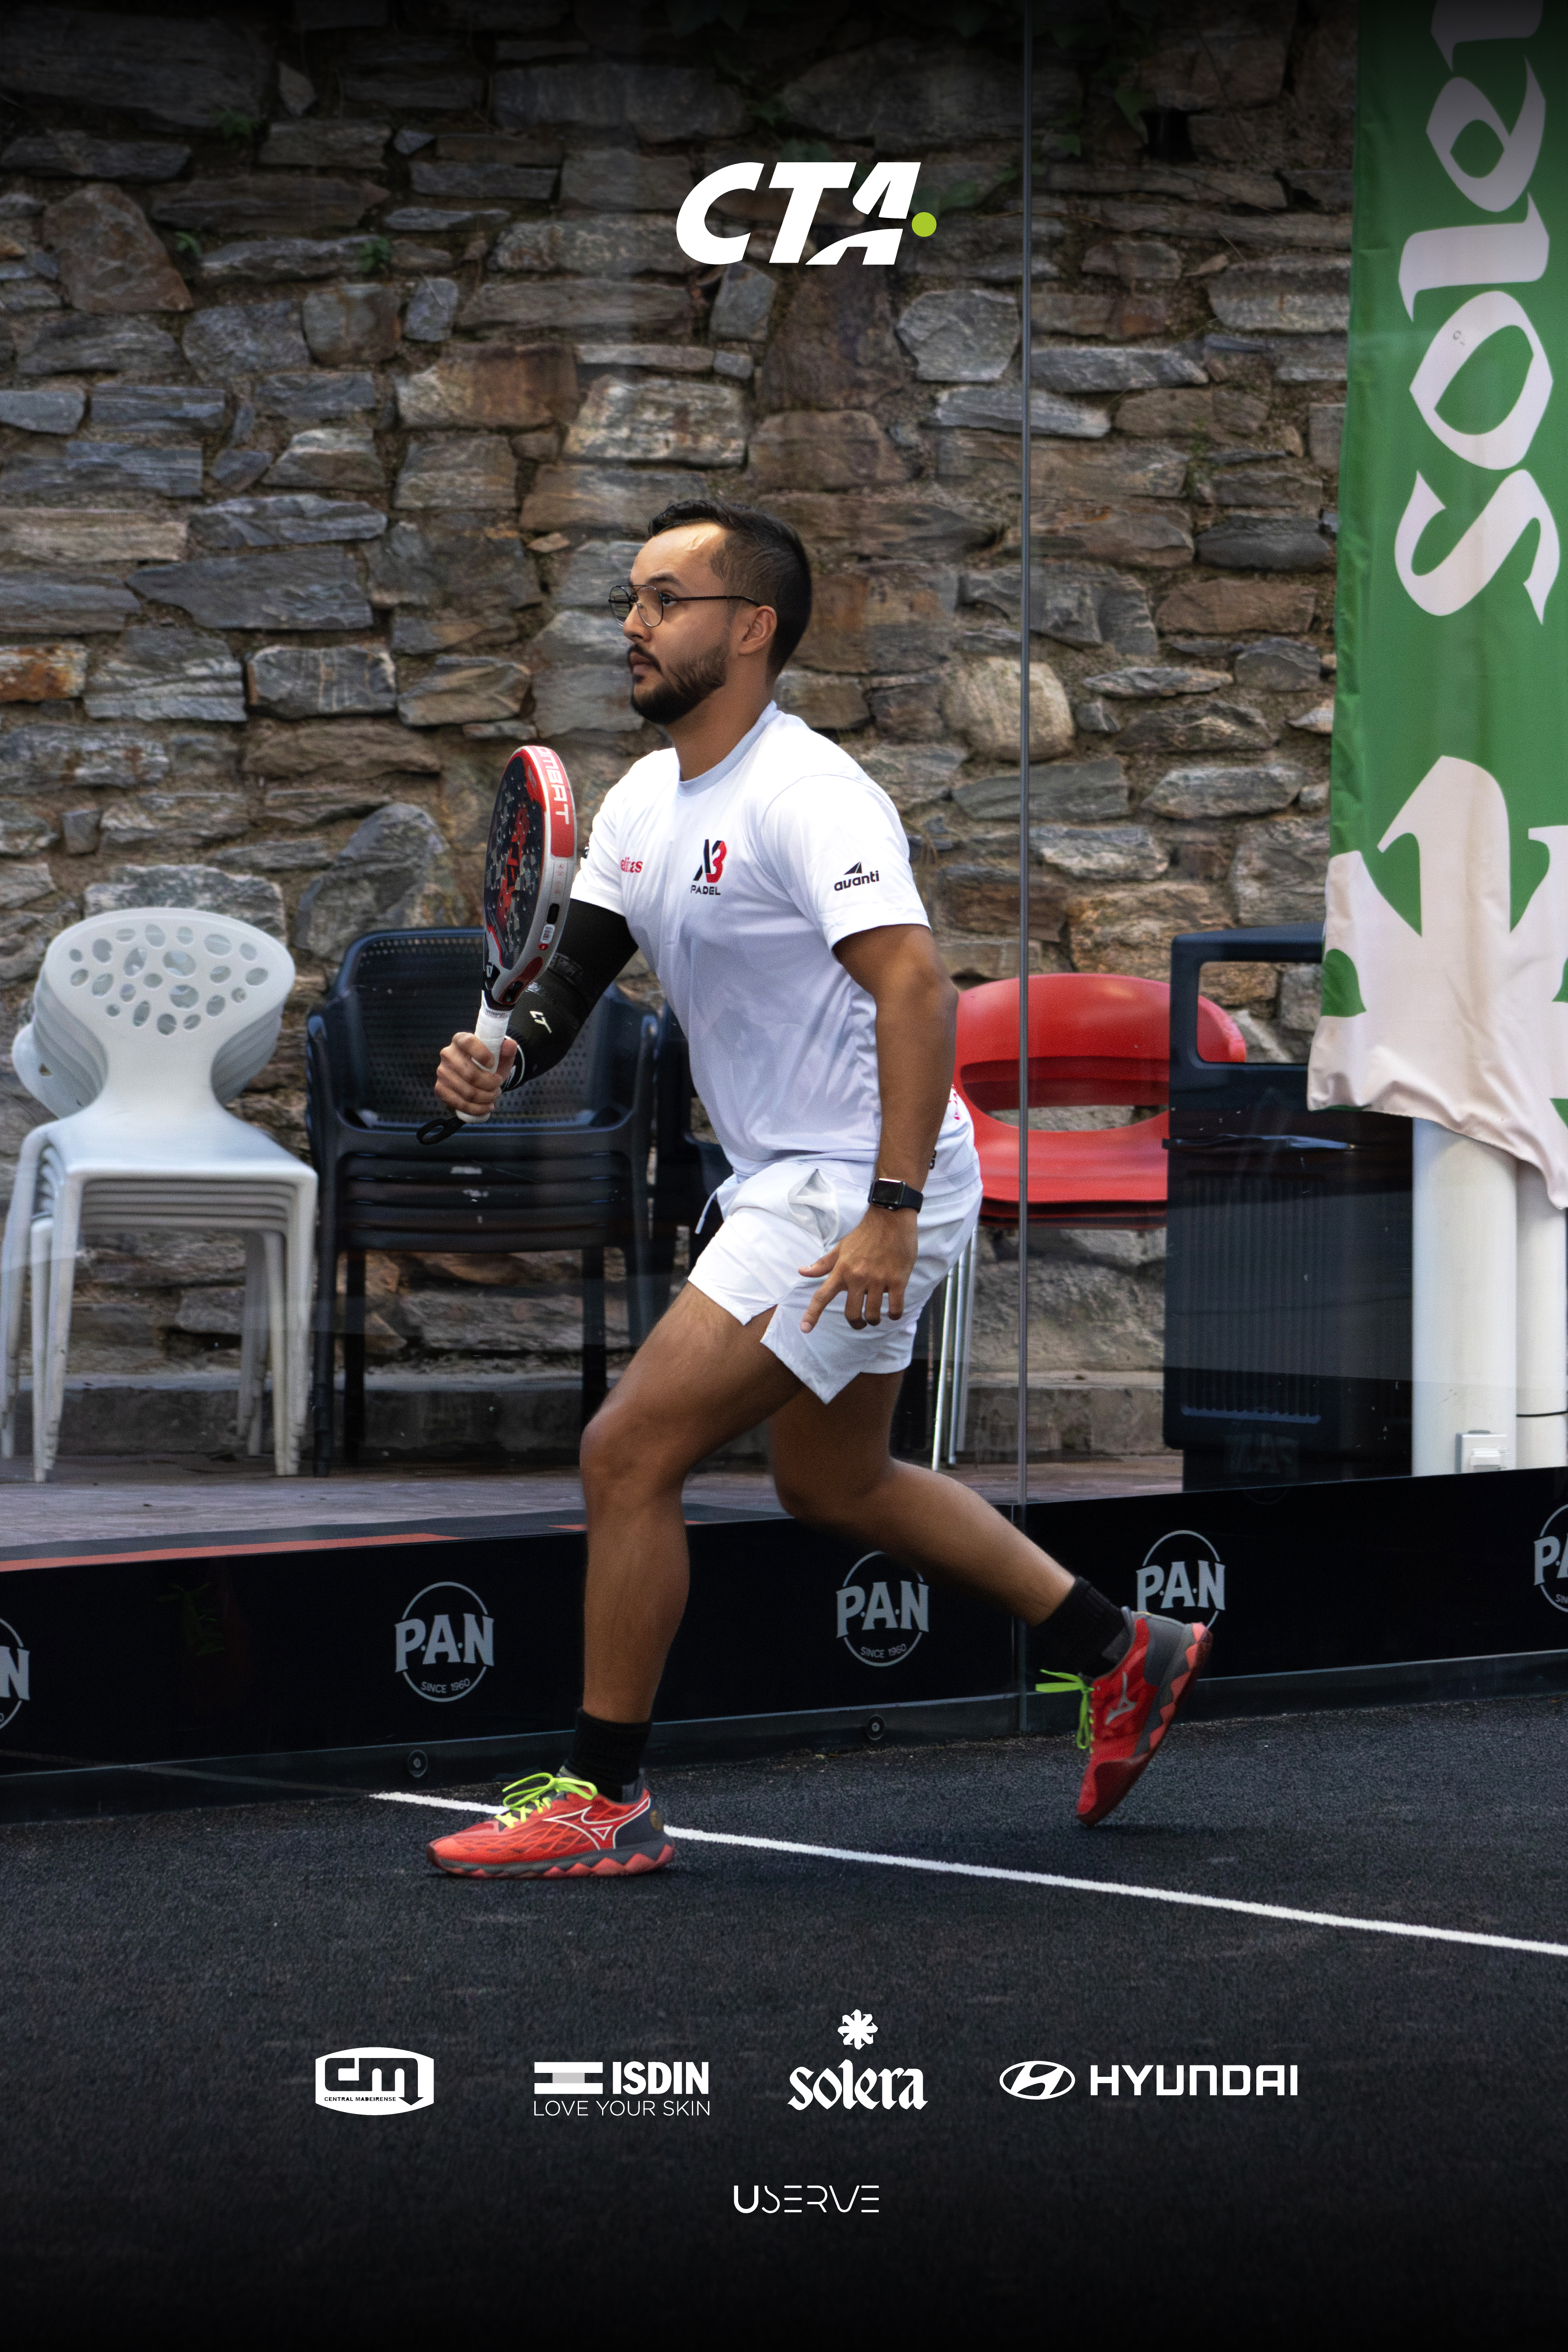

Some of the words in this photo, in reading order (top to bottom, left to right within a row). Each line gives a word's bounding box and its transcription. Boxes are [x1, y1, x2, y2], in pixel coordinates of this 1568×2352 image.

[834, 870, 879, 891] avanti
[690, 884, 721, 895] PADEL
[860, 1646, 885, 1658] SINCE
[420, 1681, 447, 1693] SINCE
